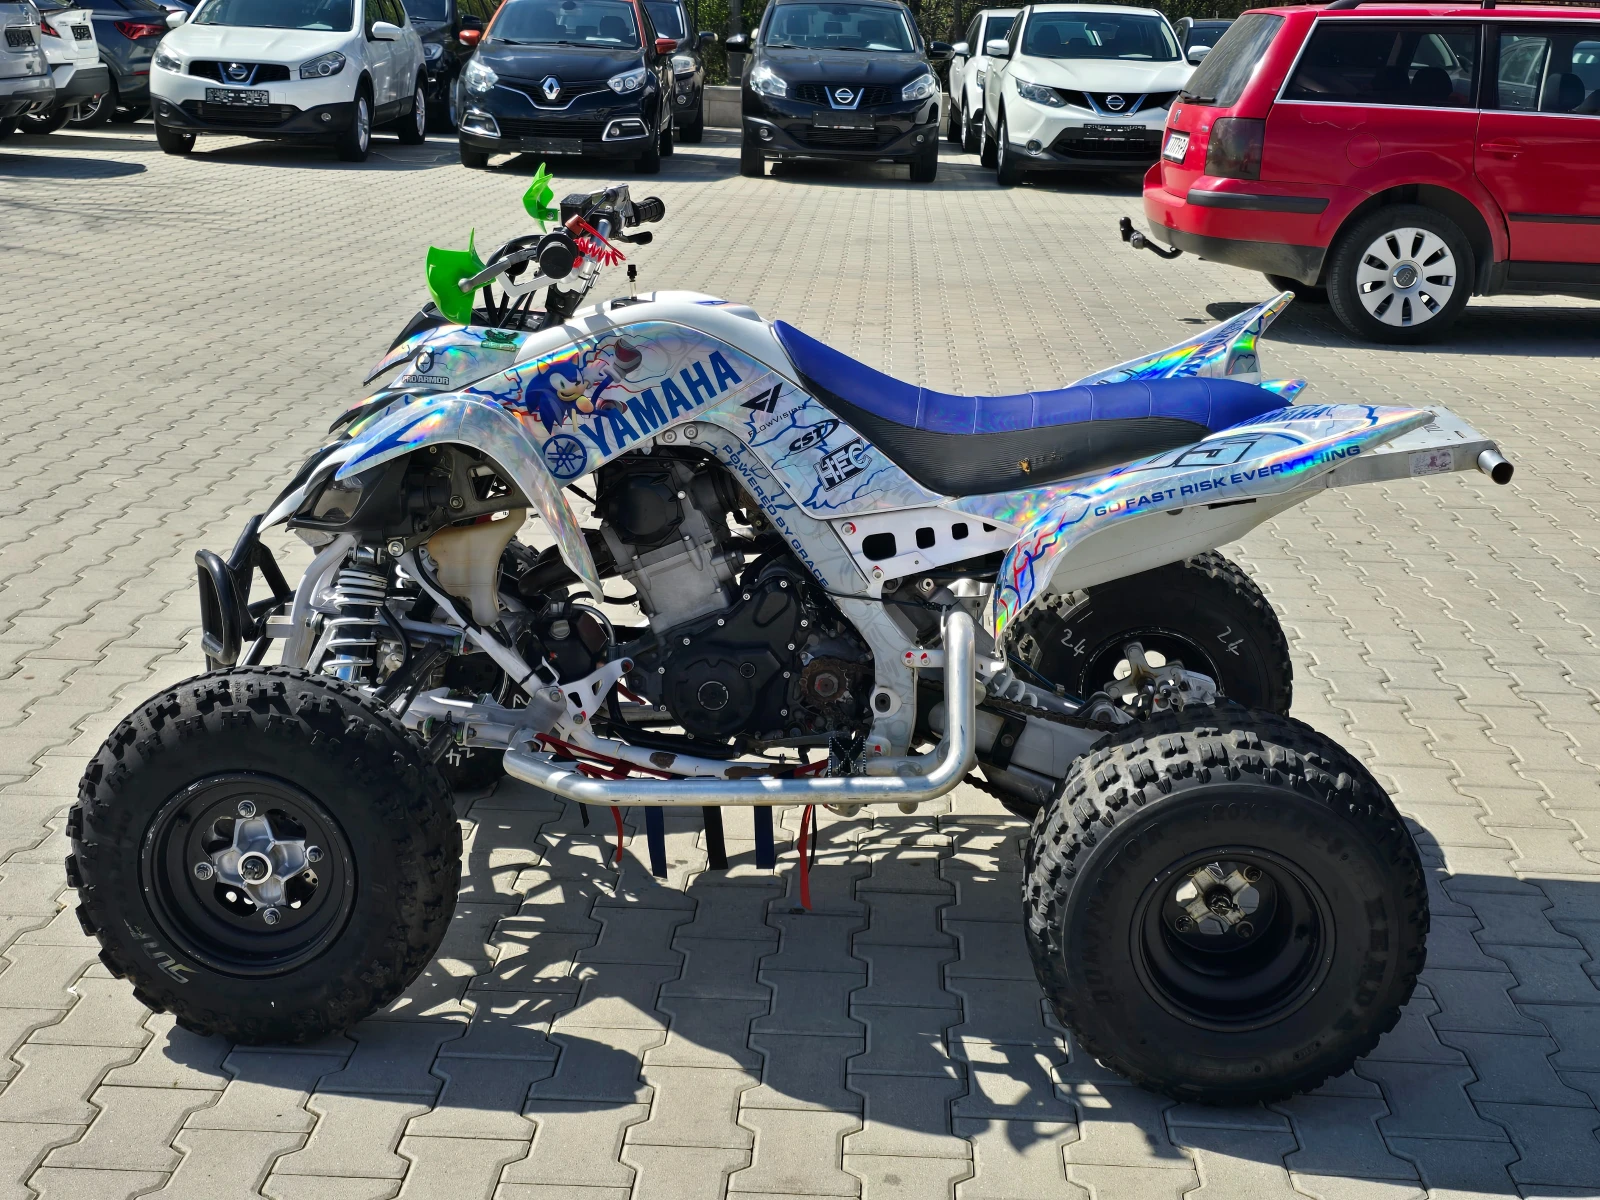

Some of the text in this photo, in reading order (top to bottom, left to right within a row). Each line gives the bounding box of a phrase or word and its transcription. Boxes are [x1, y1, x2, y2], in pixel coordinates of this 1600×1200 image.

[581, 350, 742, 458] YAMAHA
[788, 424, 827, 451] CST
[1095, 444, 1361, 517] GO FAST RISK EVERYTHING
[722, 444, 829, 587] POWERED BY GRACE
[1060, 628, 1086, 657] 24
[1216, 625, 1244, 656] 24
